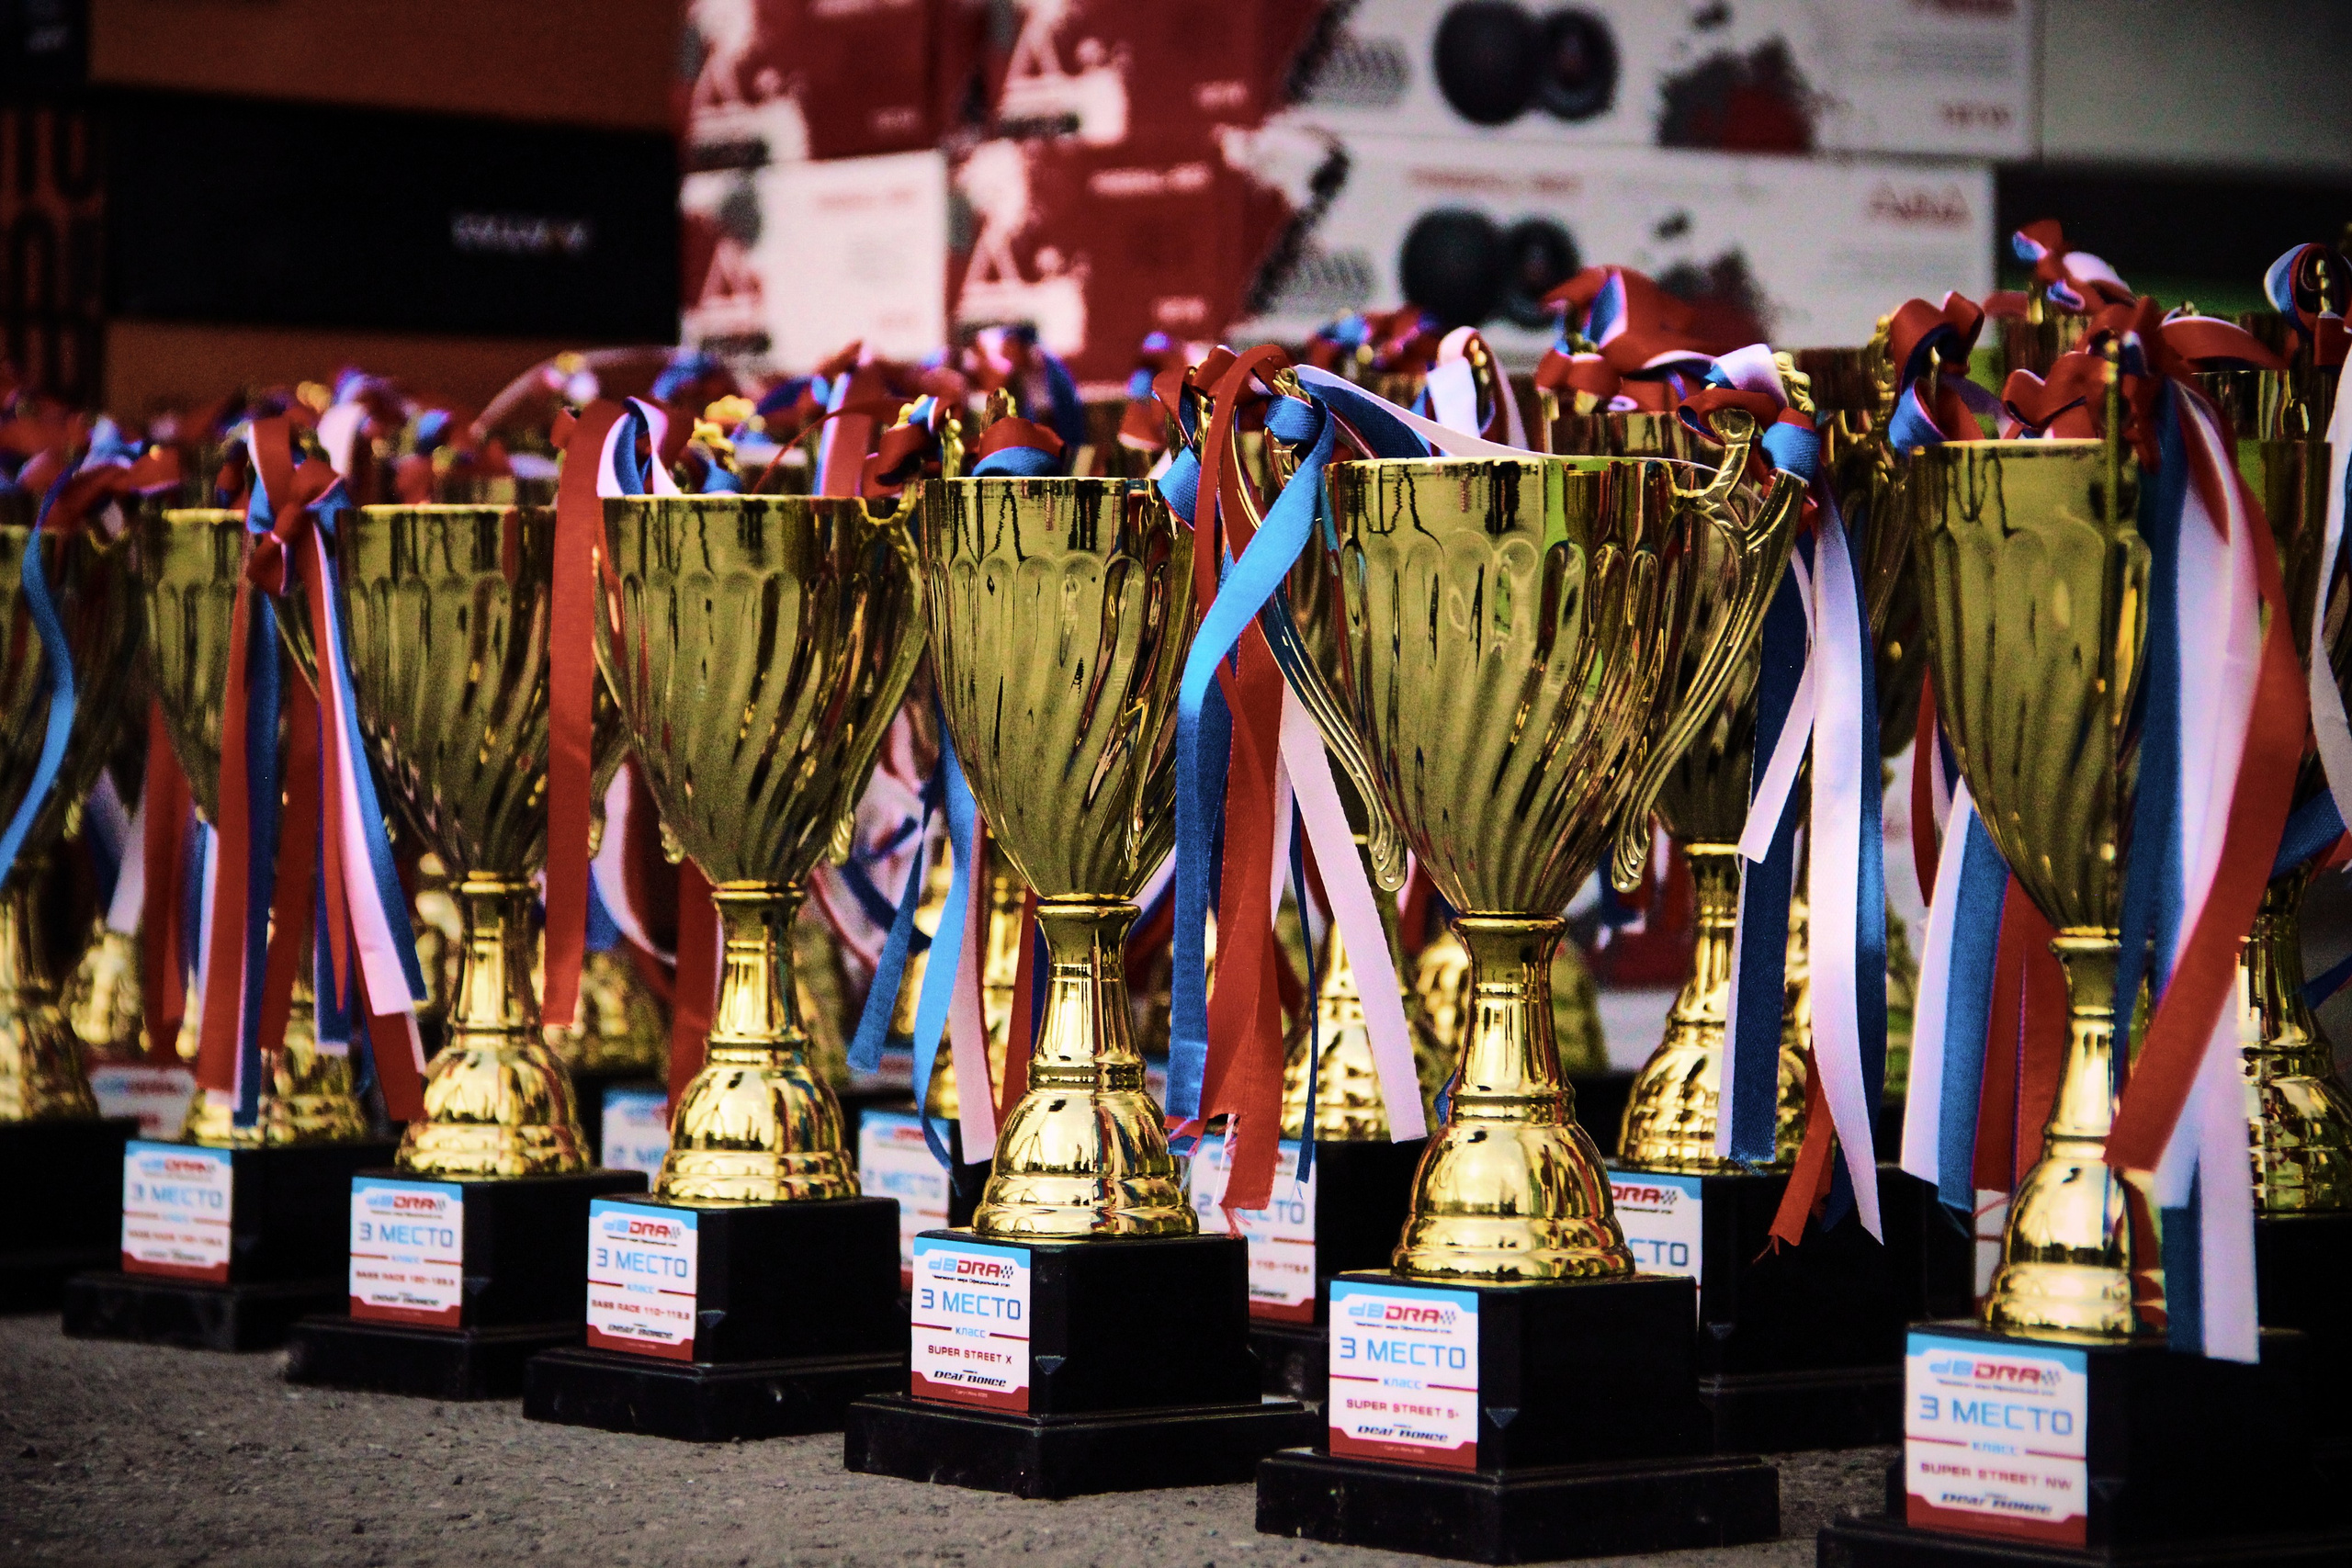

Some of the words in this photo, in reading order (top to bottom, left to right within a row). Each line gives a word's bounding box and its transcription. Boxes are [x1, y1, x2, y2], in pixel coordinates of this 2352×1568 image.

[1611, 1185, 1661, 1204] DRA
[359, 1221, 372, 1242] 3
[379, 1223, 454, 1248] МЕСТО
[596, 1247, 608, 1268] 3
[616, 1250, 688, 1278] МЕСТО
[1628, 1237, 1689, 1267] СТО
[928, 1257, 1001, 1278] dBDRA
[592, 1299, 614, 1309] BASS
[617, 1302, 640, 1314] RACE
[921, 1288, 934, 1309] 3
[943, 1291, 1021, 1320] МЕСТО
[1348, 1303, 1440, 1324] dBDRA
[956, 1326, 986, 1338] класс
[928, 1345, 960, 1357] SUPER
[964, 1350, 1001, 1363] STREET
[1005, 1355, 1012, 1364] X
[1340, 1337, 1356, 1359] 3
[1367, 1338, 1466, 1370] МЕСТО
[1383, 1377, 1422, 1390] класс
[1346, 1399, 1387, 1411] SUPER
[1393, 1404, 1442, 1416] STREET
[1919, 1394, 1939, 1420] 3
[1952, 1398, 2074, 1436] МЕСТО
[1920, 1461, 1971, 1478] SUPER
[1978, 1469, 2037, 1486] STREET
[2045, 1477, 2073, 1491] NW
